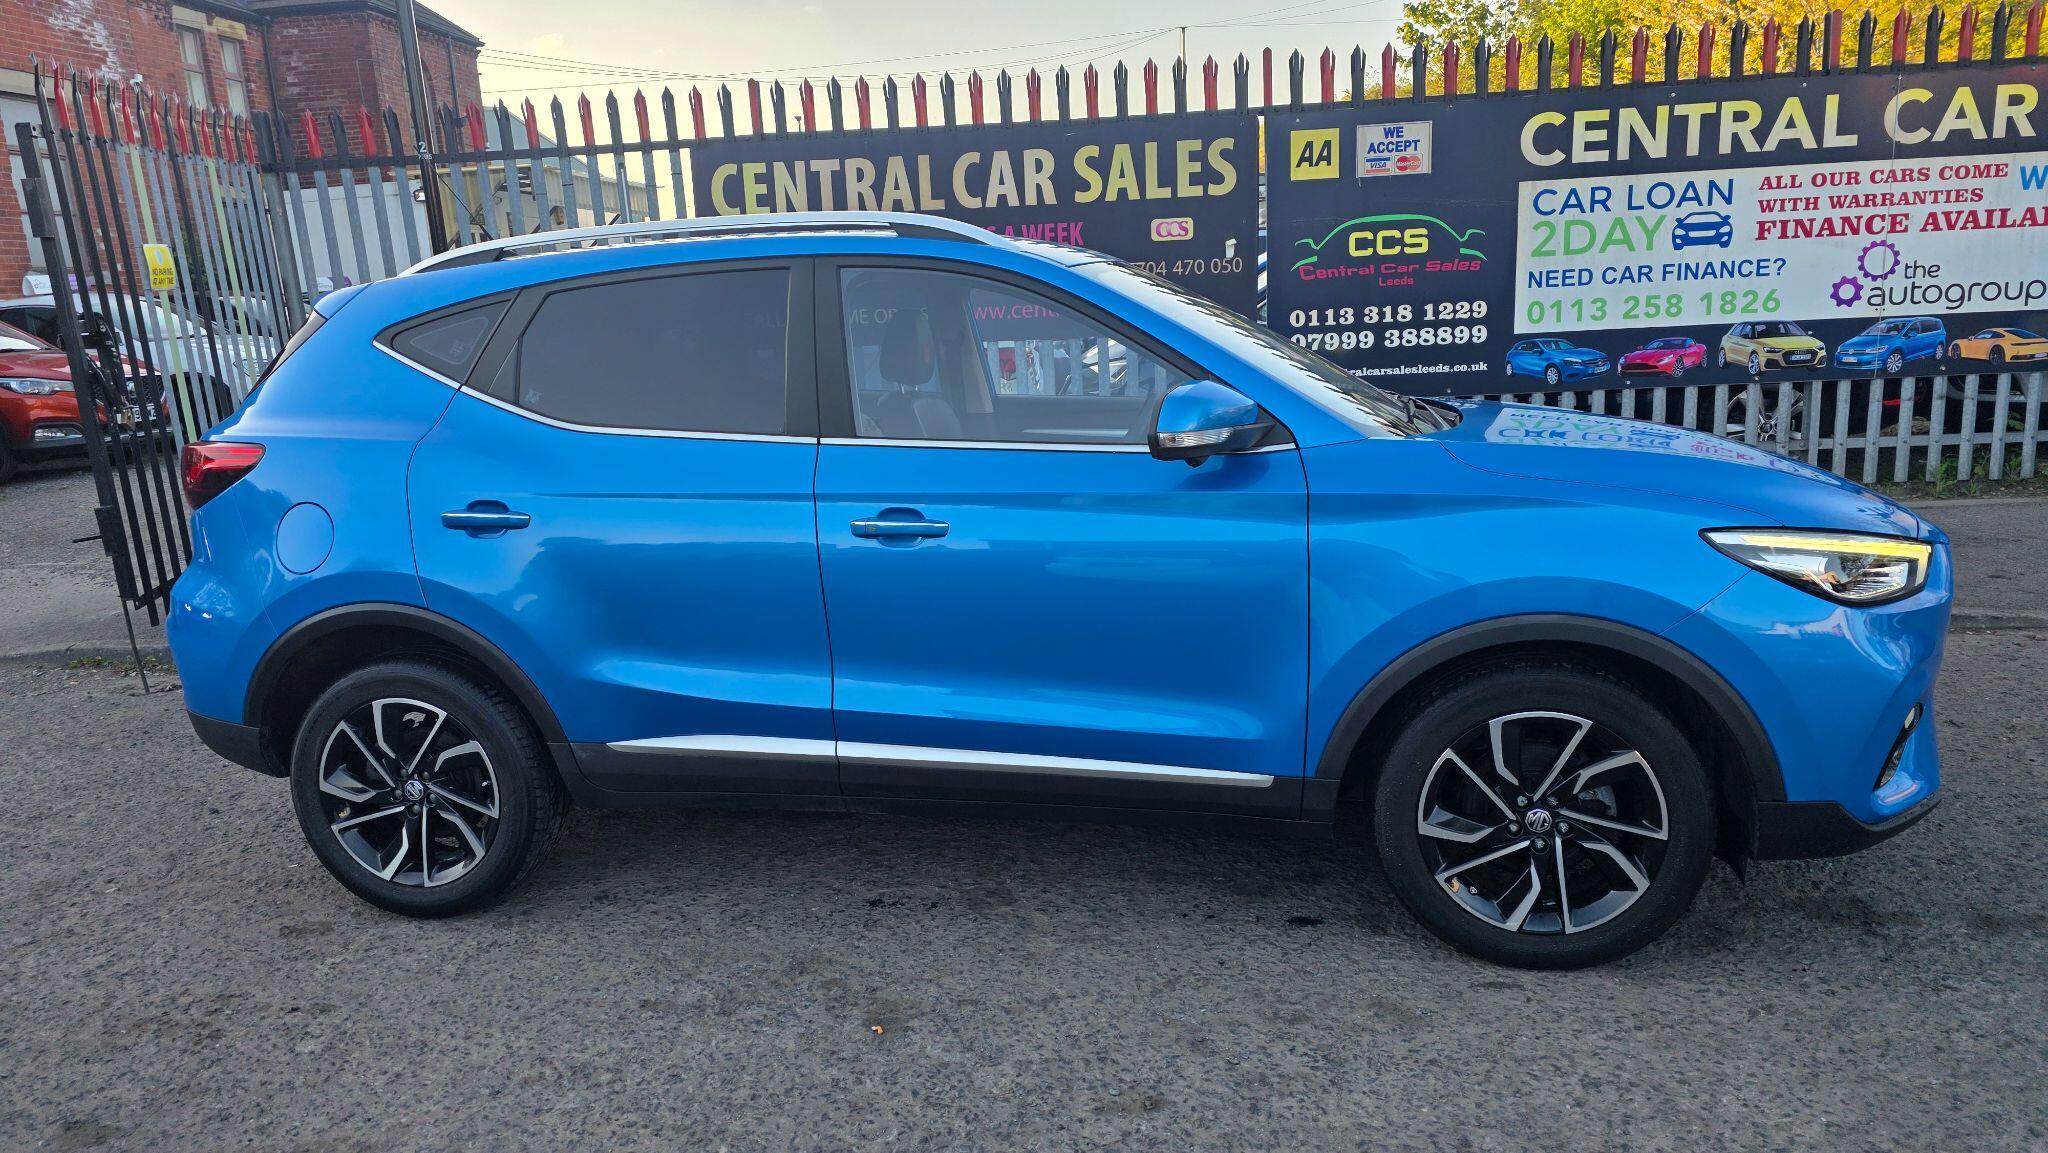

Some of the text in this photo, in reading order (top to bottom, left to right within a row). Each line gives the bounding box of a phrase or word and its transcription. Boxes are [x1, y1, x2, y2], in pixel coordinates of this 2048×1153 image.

[1383, 126, 1404, 139] WE
[1520, 83, 2038, 167] CENTRAL CAR
[1296, 140, 1332, 168] AA
[1367, 139, 1420, 154] ACCEPT
[711, 137, 1237, 215] CENTRAL CAR SALES
[1759, 163, 2008, 190] ALL OUR CARS COME
[1532, 179, 1734, 215] CAR LOAN
[1758, 187, 1984, 213] WITH WARRANTIES
[1021, 222, 1084, 246] WEEK
[1156, 221, 1189, 237] CCS
[1530, 215, 1667, 257] 2DAY
[1755, 213, 1910, 241] FINANCE
[1348, 227, 1429, 257] CCS
[1173, 259, 1205, 276] 470
[1210, 257, 1242, 274] 050
[1299, 258, 1482, 281] Central Car Sales
[1527, 257, 1787, 289] NEED CAR FINANCE?
[1904, 259, 1941, 279] the
[1378, 276, 1414, 286] Leeds
[1867, 279, 2048, 310] autogroup
[1289, 300, 1488, 328] 0113 318 1229
[1527, 288, 1781, 325] 0113 258 1826
[1290, 325, 1488, 351] 07999 388899
